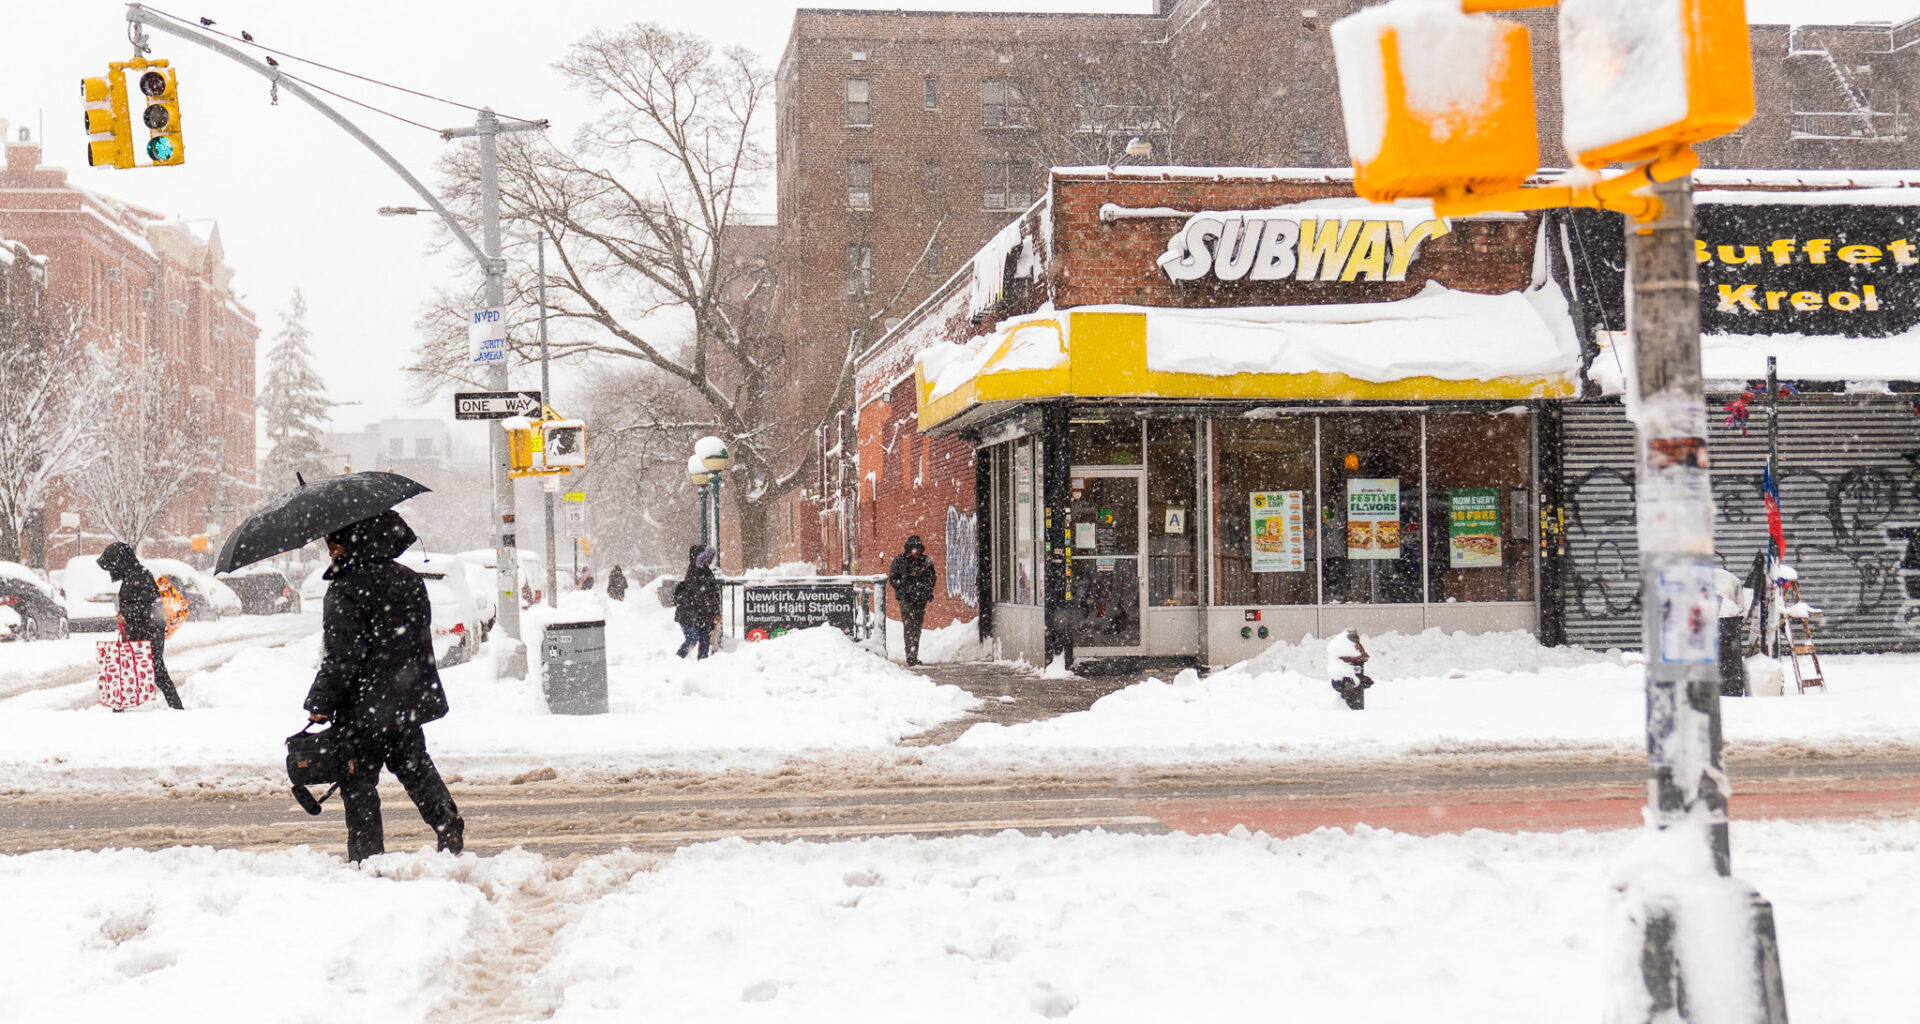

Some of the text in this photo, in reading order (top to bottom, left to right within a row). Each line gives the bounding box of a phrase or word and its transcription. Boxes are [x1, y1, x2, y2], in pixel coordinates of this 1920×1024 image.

[1158, 217, 1451, 284] SUBWAY
[1717, 284, 1879, 312] Kreol
[474, 311, 500, 324] NYPD
[462, 399, 532, 412] ONE WAY
[1350, 493, 1397, 503] FESTIVE
[1452, 495, 1496, 505] NOW EVERY
[1350, 503, 1397, 511] FLAVORS
[570, 513, 581, 521] 15
[1168, 513, 1180, 526] A
[1452, 510, 1497, 521] IS FREE
[746, 590, 845, 601] Newkirk Avenue-
[746, 602, 851, 614] Little Haiti Station
